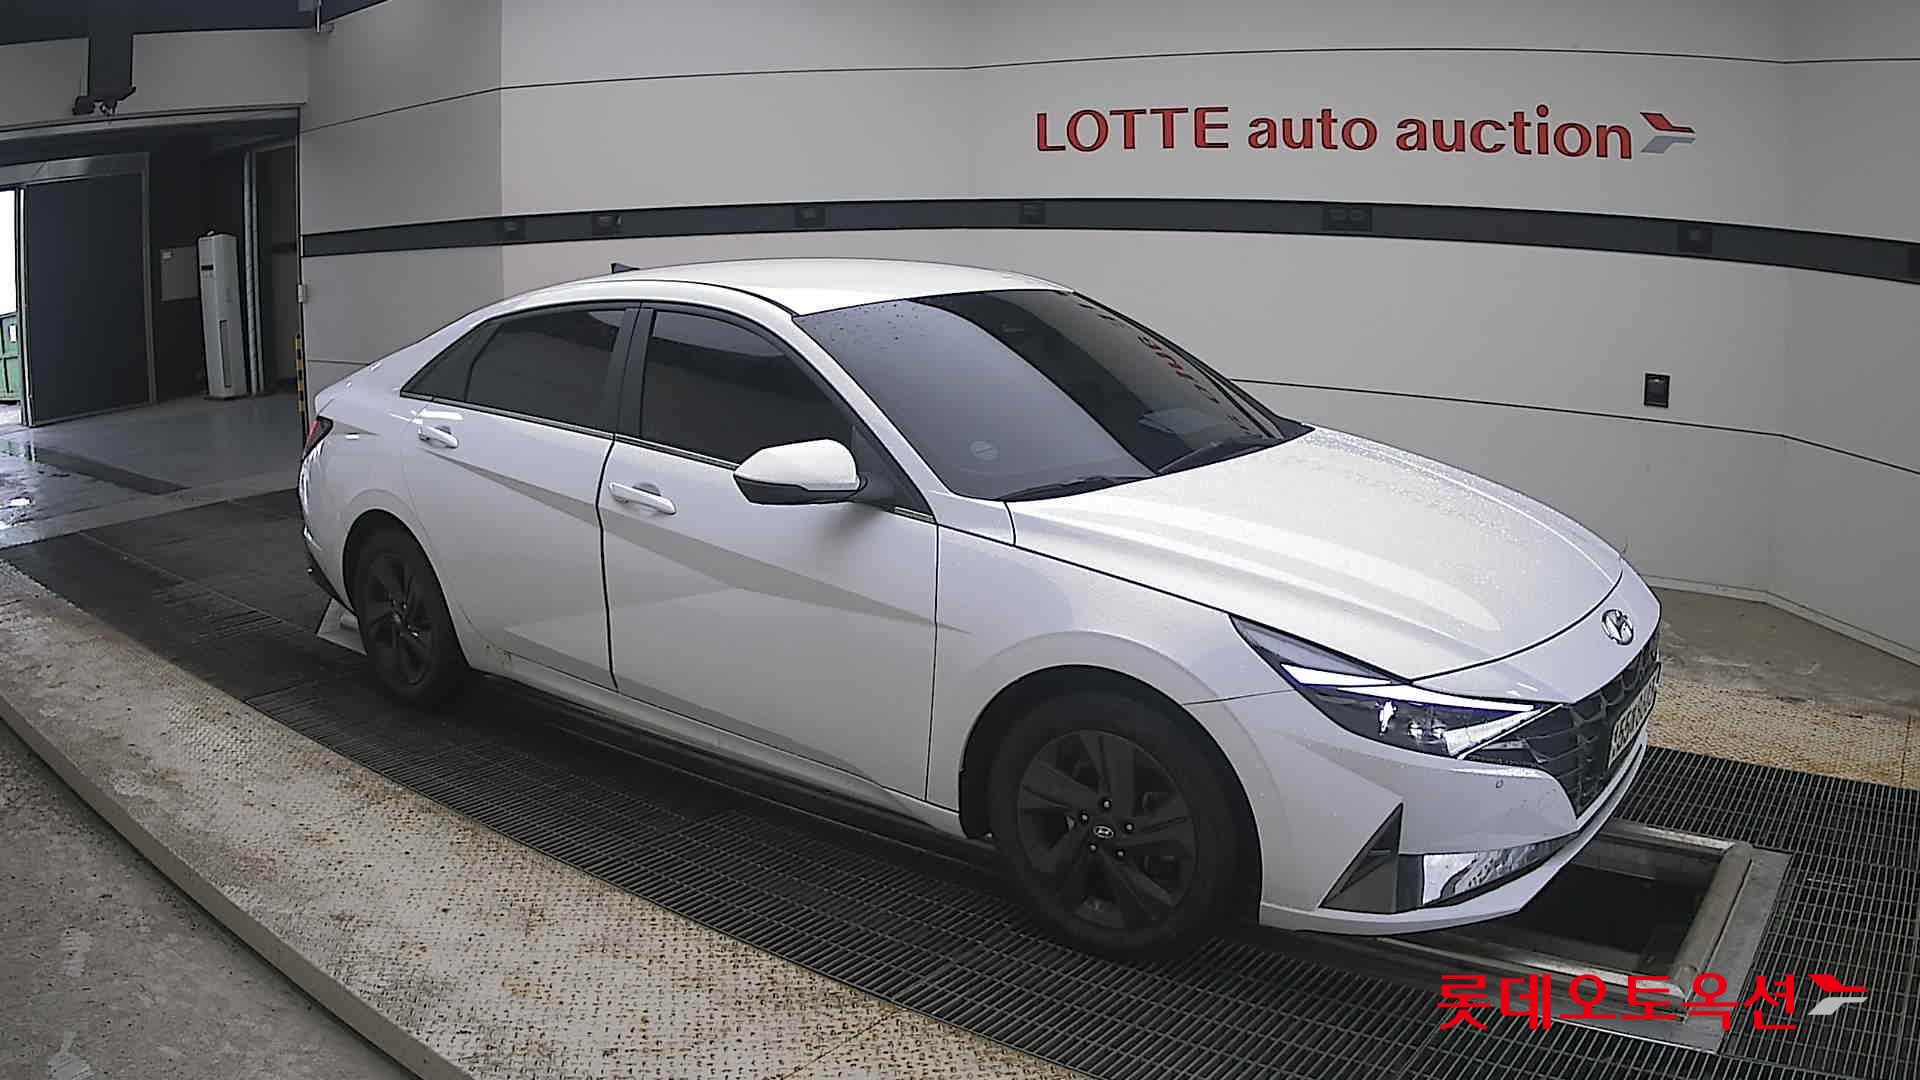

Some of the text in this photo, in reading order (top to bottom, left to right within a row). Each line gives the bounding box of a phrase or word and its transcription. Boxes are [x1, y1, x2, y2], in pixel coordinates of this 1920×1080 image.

[1036, 104, 1634, 159] LOTTE auto auction
